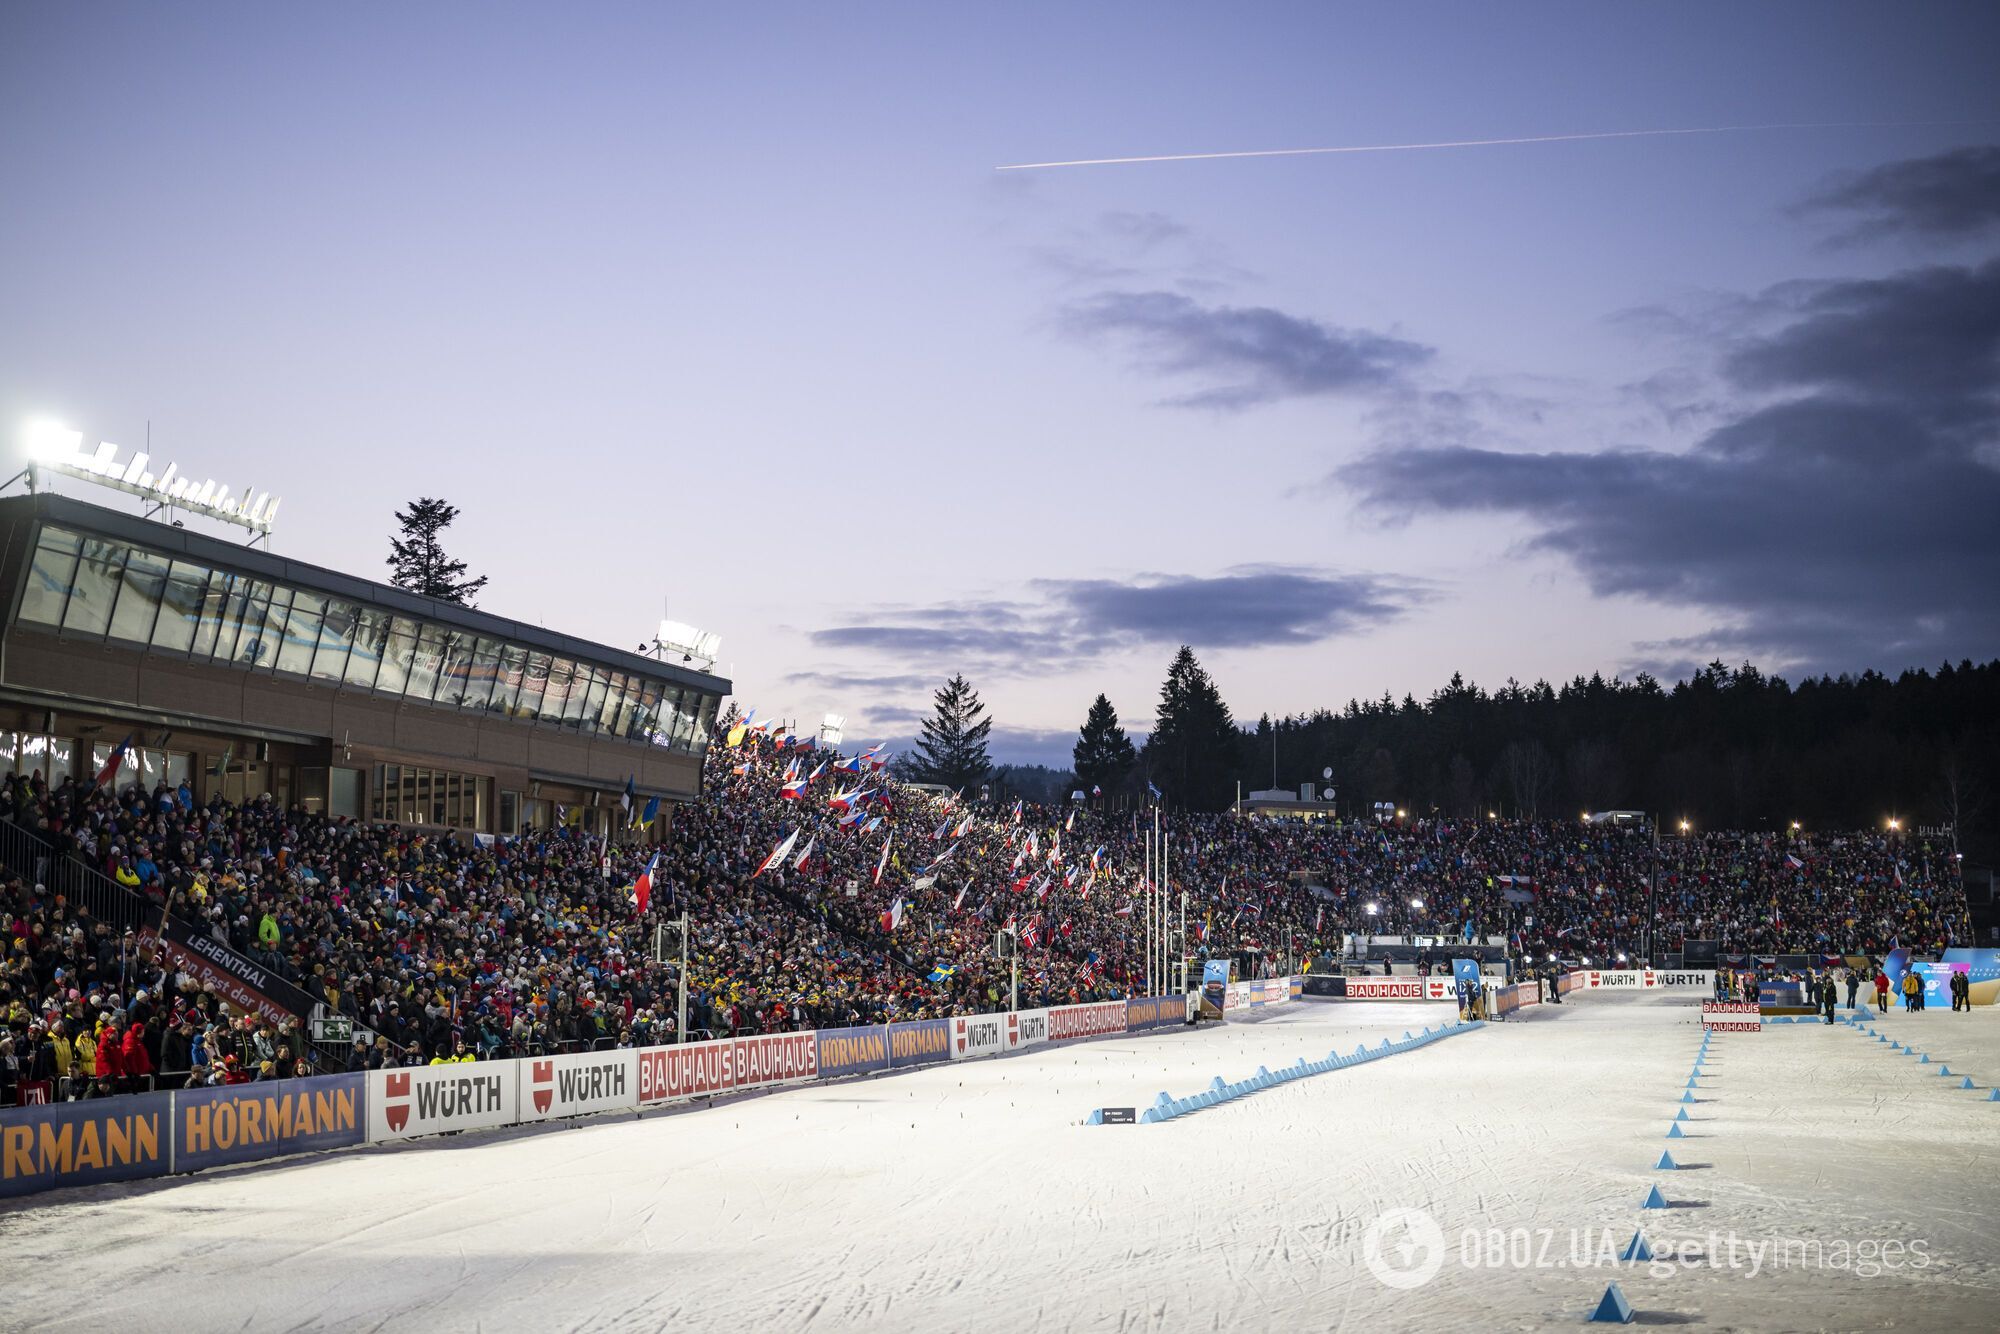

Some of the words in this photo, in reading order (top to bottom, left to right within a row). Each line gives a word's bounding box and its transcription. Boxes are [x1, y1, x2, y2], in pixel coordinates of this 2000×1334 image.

[187, 934, 267, 988] LEHENTHAL
[200, 967, 230, 993] Rest
[230, 984, 255, 1007] der
[1347, 985, 1421, 996] BAUHAUS
[1049, 1011, 1091, 1036] BAUHAUS
[1092, 1005, 1126, 1031] BAUHAUS
[1704, 1004, 1760, 1012] BAUHAUS
[1704, 1023, 1760, 1031] BAUHAUS
[641, 1050, 733, 1093] BAUHAUS
[737, 1041, 816, 1078] BAUHAUS
[821, 1034, 885, 1068] HÖRMANN
[892, 1027, 947, 1058] HÖRMANN
[186, 1087, 356, 1153] HÖRMANN
[0, 1112, 158, 1179] RMANN
